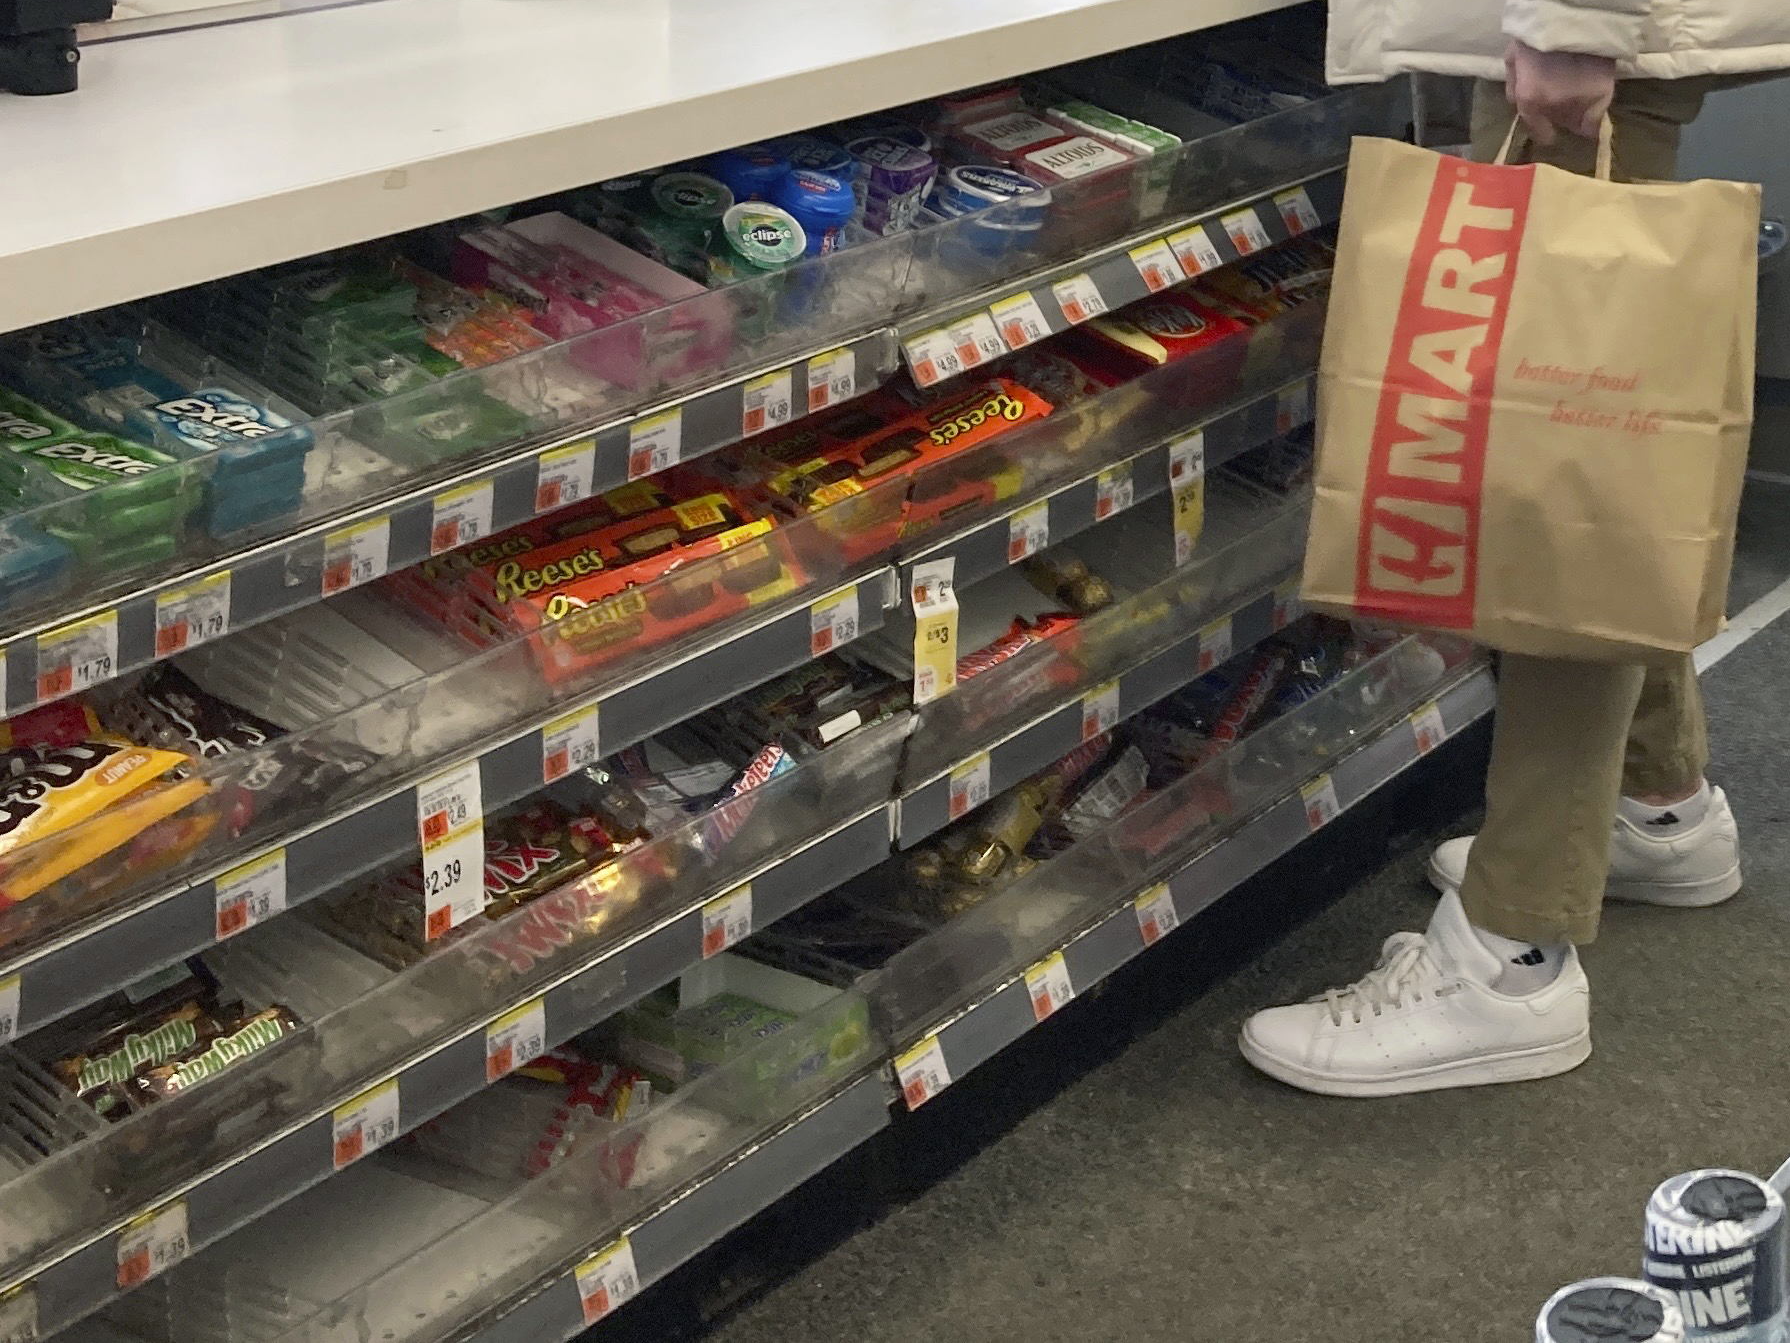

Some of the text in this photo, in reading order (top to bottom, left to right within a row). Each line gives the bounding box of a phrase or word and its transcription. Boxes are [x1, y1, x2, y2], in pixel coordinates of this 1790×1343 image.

[980, 114, 1043, 142] ALTOIDS
[1040, 141, 1106, 170] ALTOIDS
[741, 227, 793, 243] eclipse
[1387, 179, 1515, 485] MART
[1576, 365, 1640, 398] food
[929, 393, 1025, 446] Reese's
[495, 545, 605, 604] Reese's
[101, 754, 147, 785] PEANUT
[425, 858, 462, 897] $2.39
